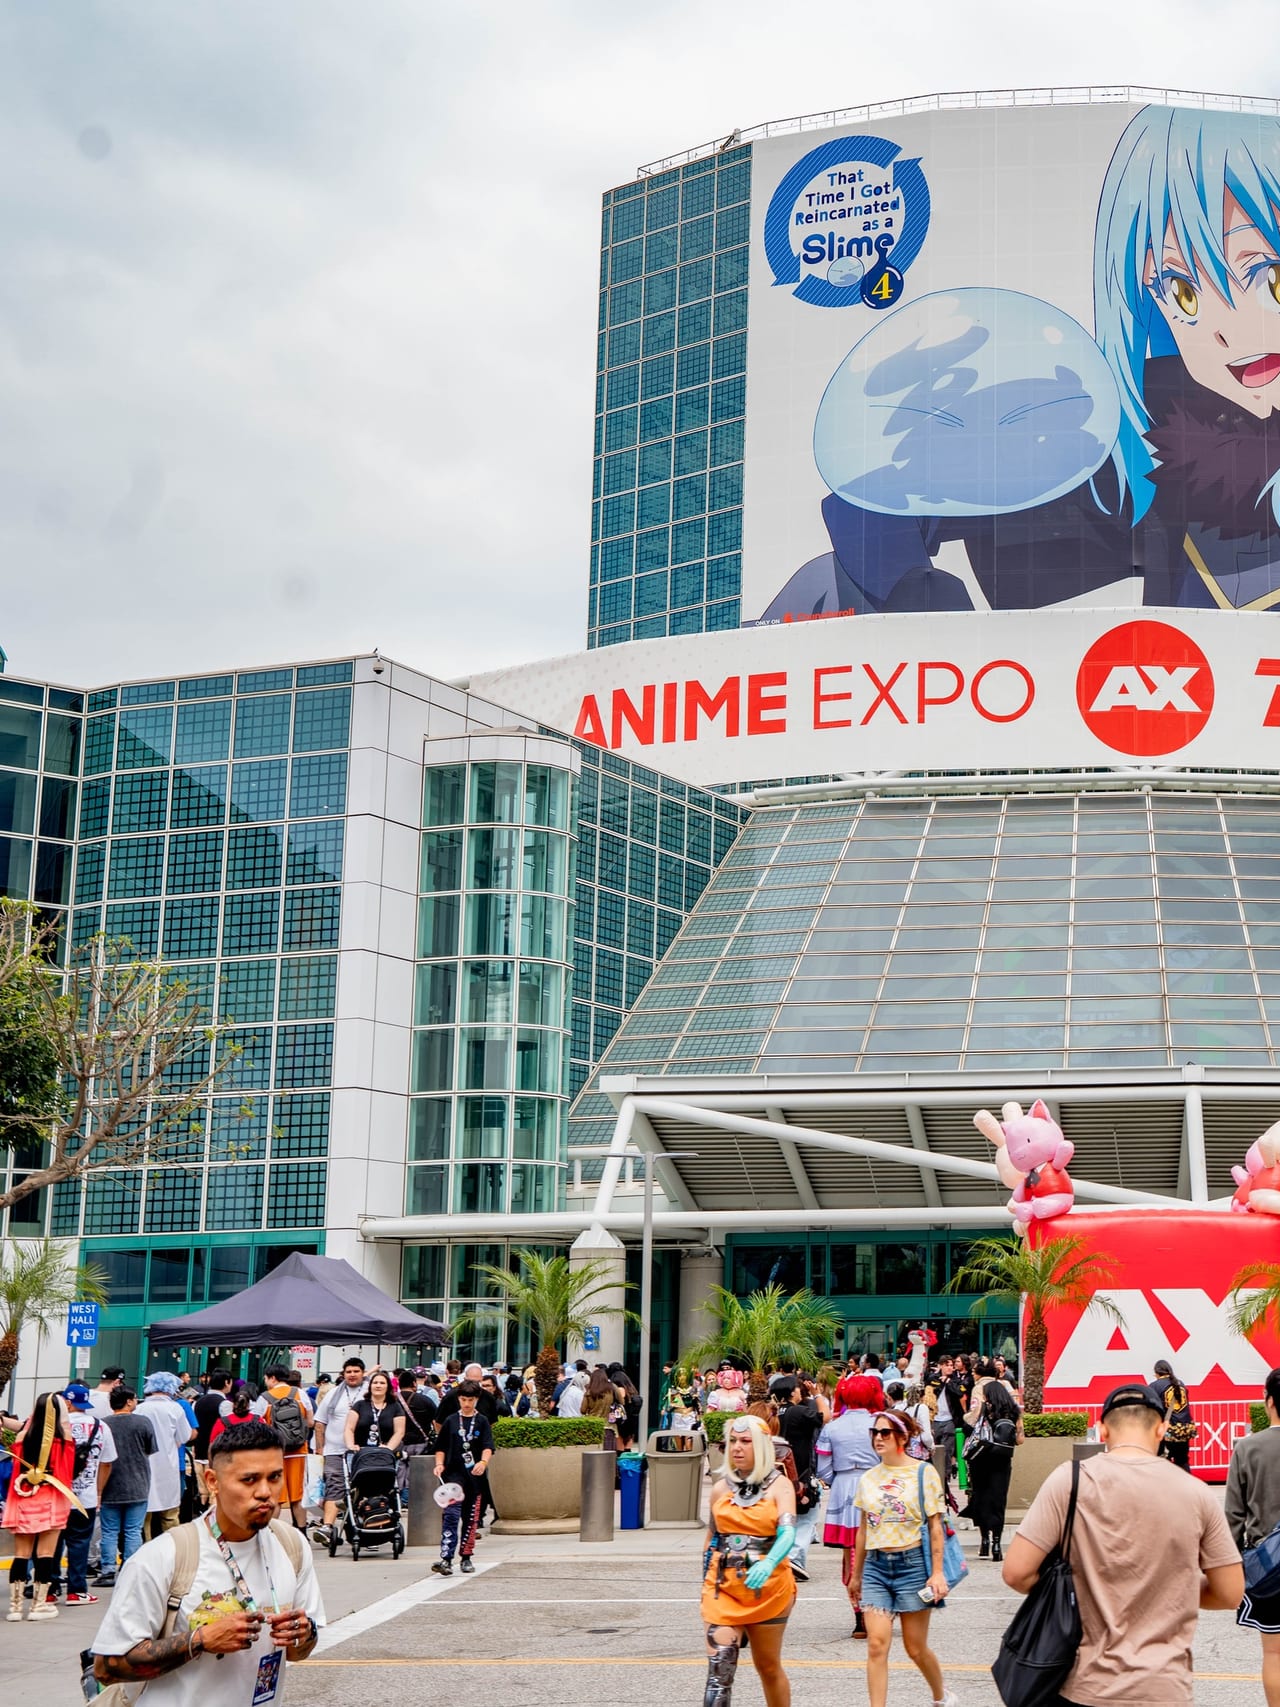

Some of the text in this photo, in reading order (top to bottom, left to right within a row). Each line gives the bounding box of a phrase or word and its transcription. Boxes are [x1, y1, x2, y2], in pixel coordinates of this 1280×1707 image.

[827, 169, 864, 187] That
[805, 182, 890, 207] Time I Got
[795, 197, 900, 226] Reincarnated
[862, 217, 893, 232] as a
[802, 231, 895, 264] Slime
[871, 273, 894, 300] 4
[1088, 665, 1203, 712] AX
[573, 659, 1035, 749] ANIME EXPO
[71, 1304, 96, 1314] WEST
[71, 1315, 95, 1324] HALL
[1044, 1288, 1274, 1388] AX
